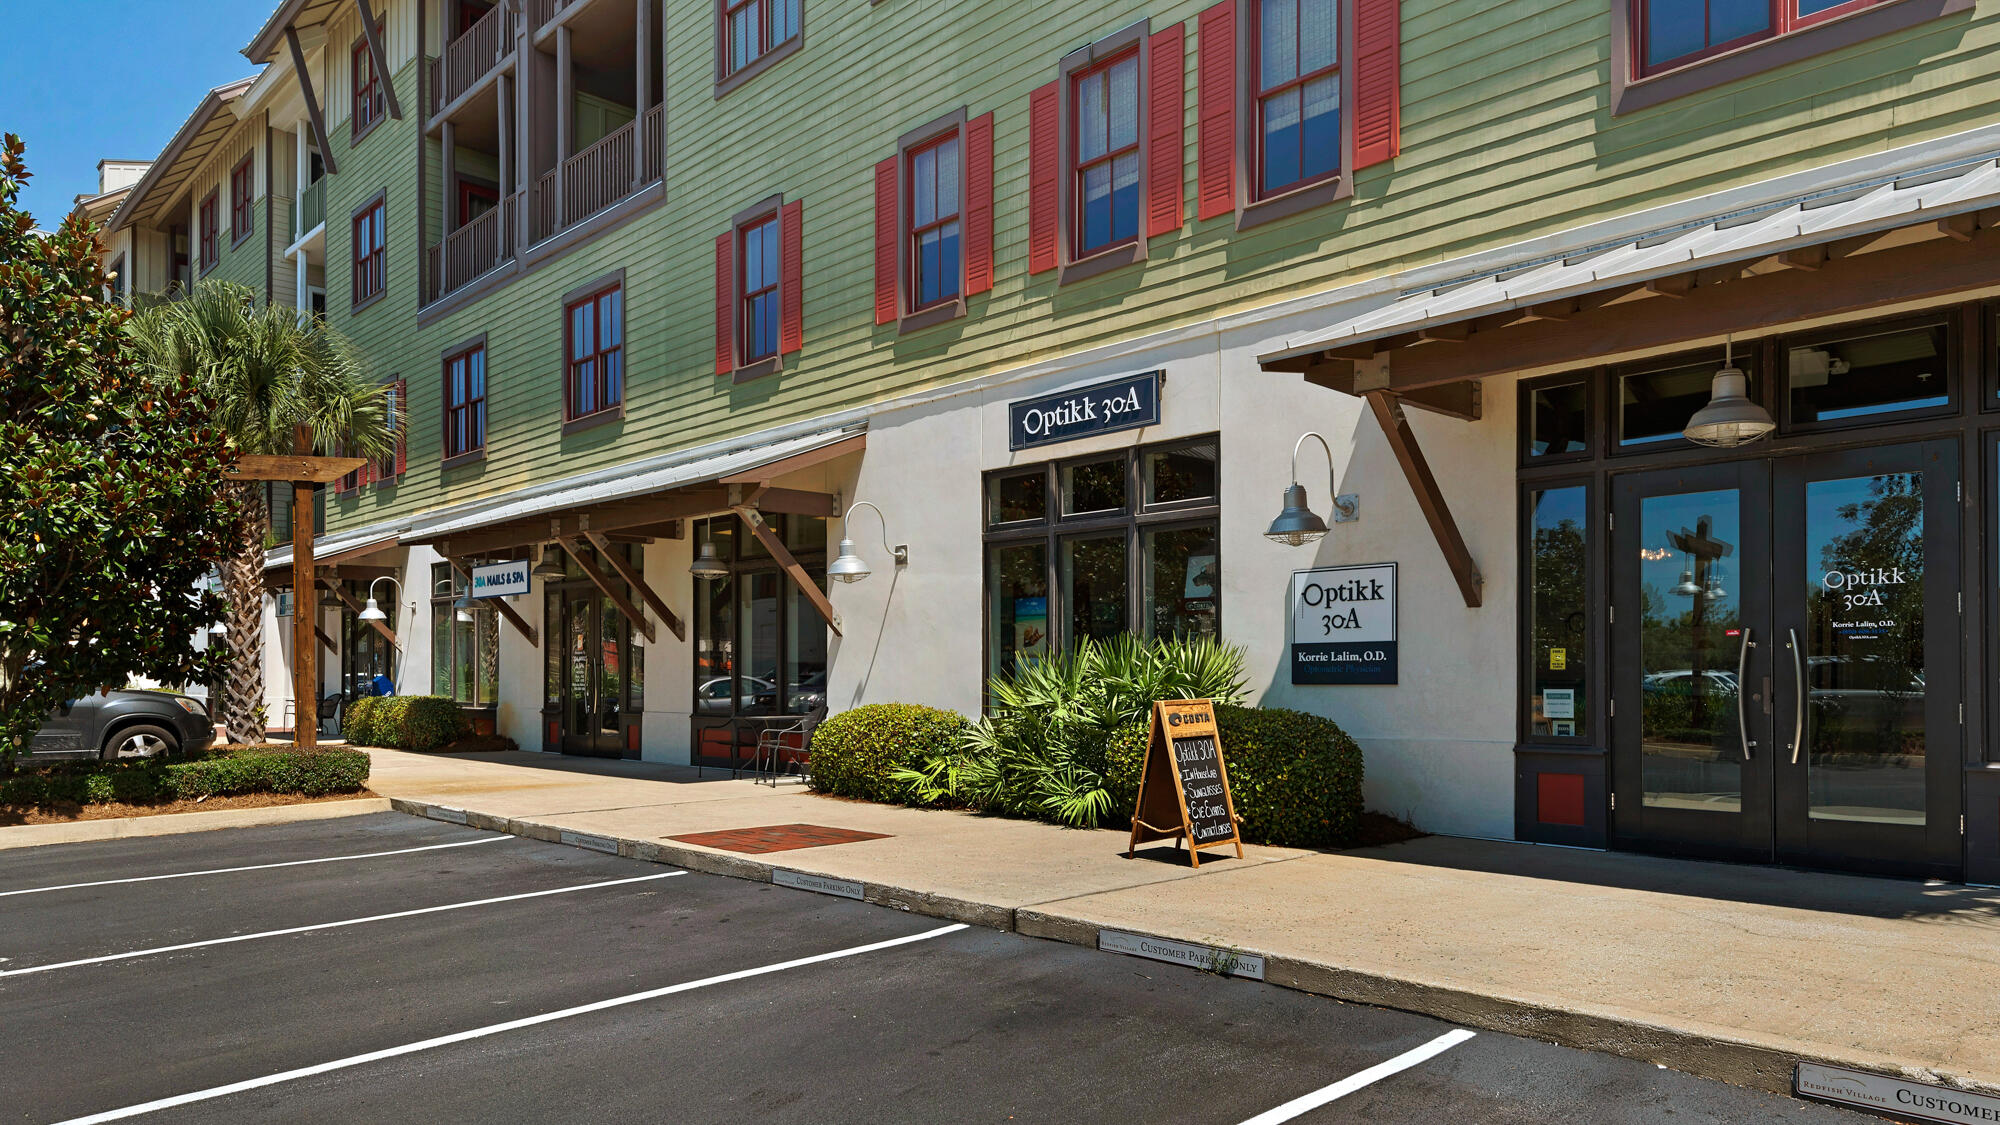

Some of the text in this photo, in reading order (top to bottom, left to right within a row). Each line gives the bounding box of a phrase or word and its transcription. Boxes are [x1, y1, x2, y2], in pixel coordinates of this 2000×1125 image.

[1023, 386, 1142, 435] Optikk 30A
[475, 571, 525, 588] 30A NAILS & SPA
[1822, 567, 1906, 591] Optikk
[1302, 579, 1384, 608] Optikk
[1843, 589, 1883, 611] 30A
[1322, 608, 1362, 635] 30A
[1298, 650, 1387, 663] Korrie Lalim, O.D.
[1183, 713, 1210, 724] COSTA
[1198, 740, 1216, 760] 30A
